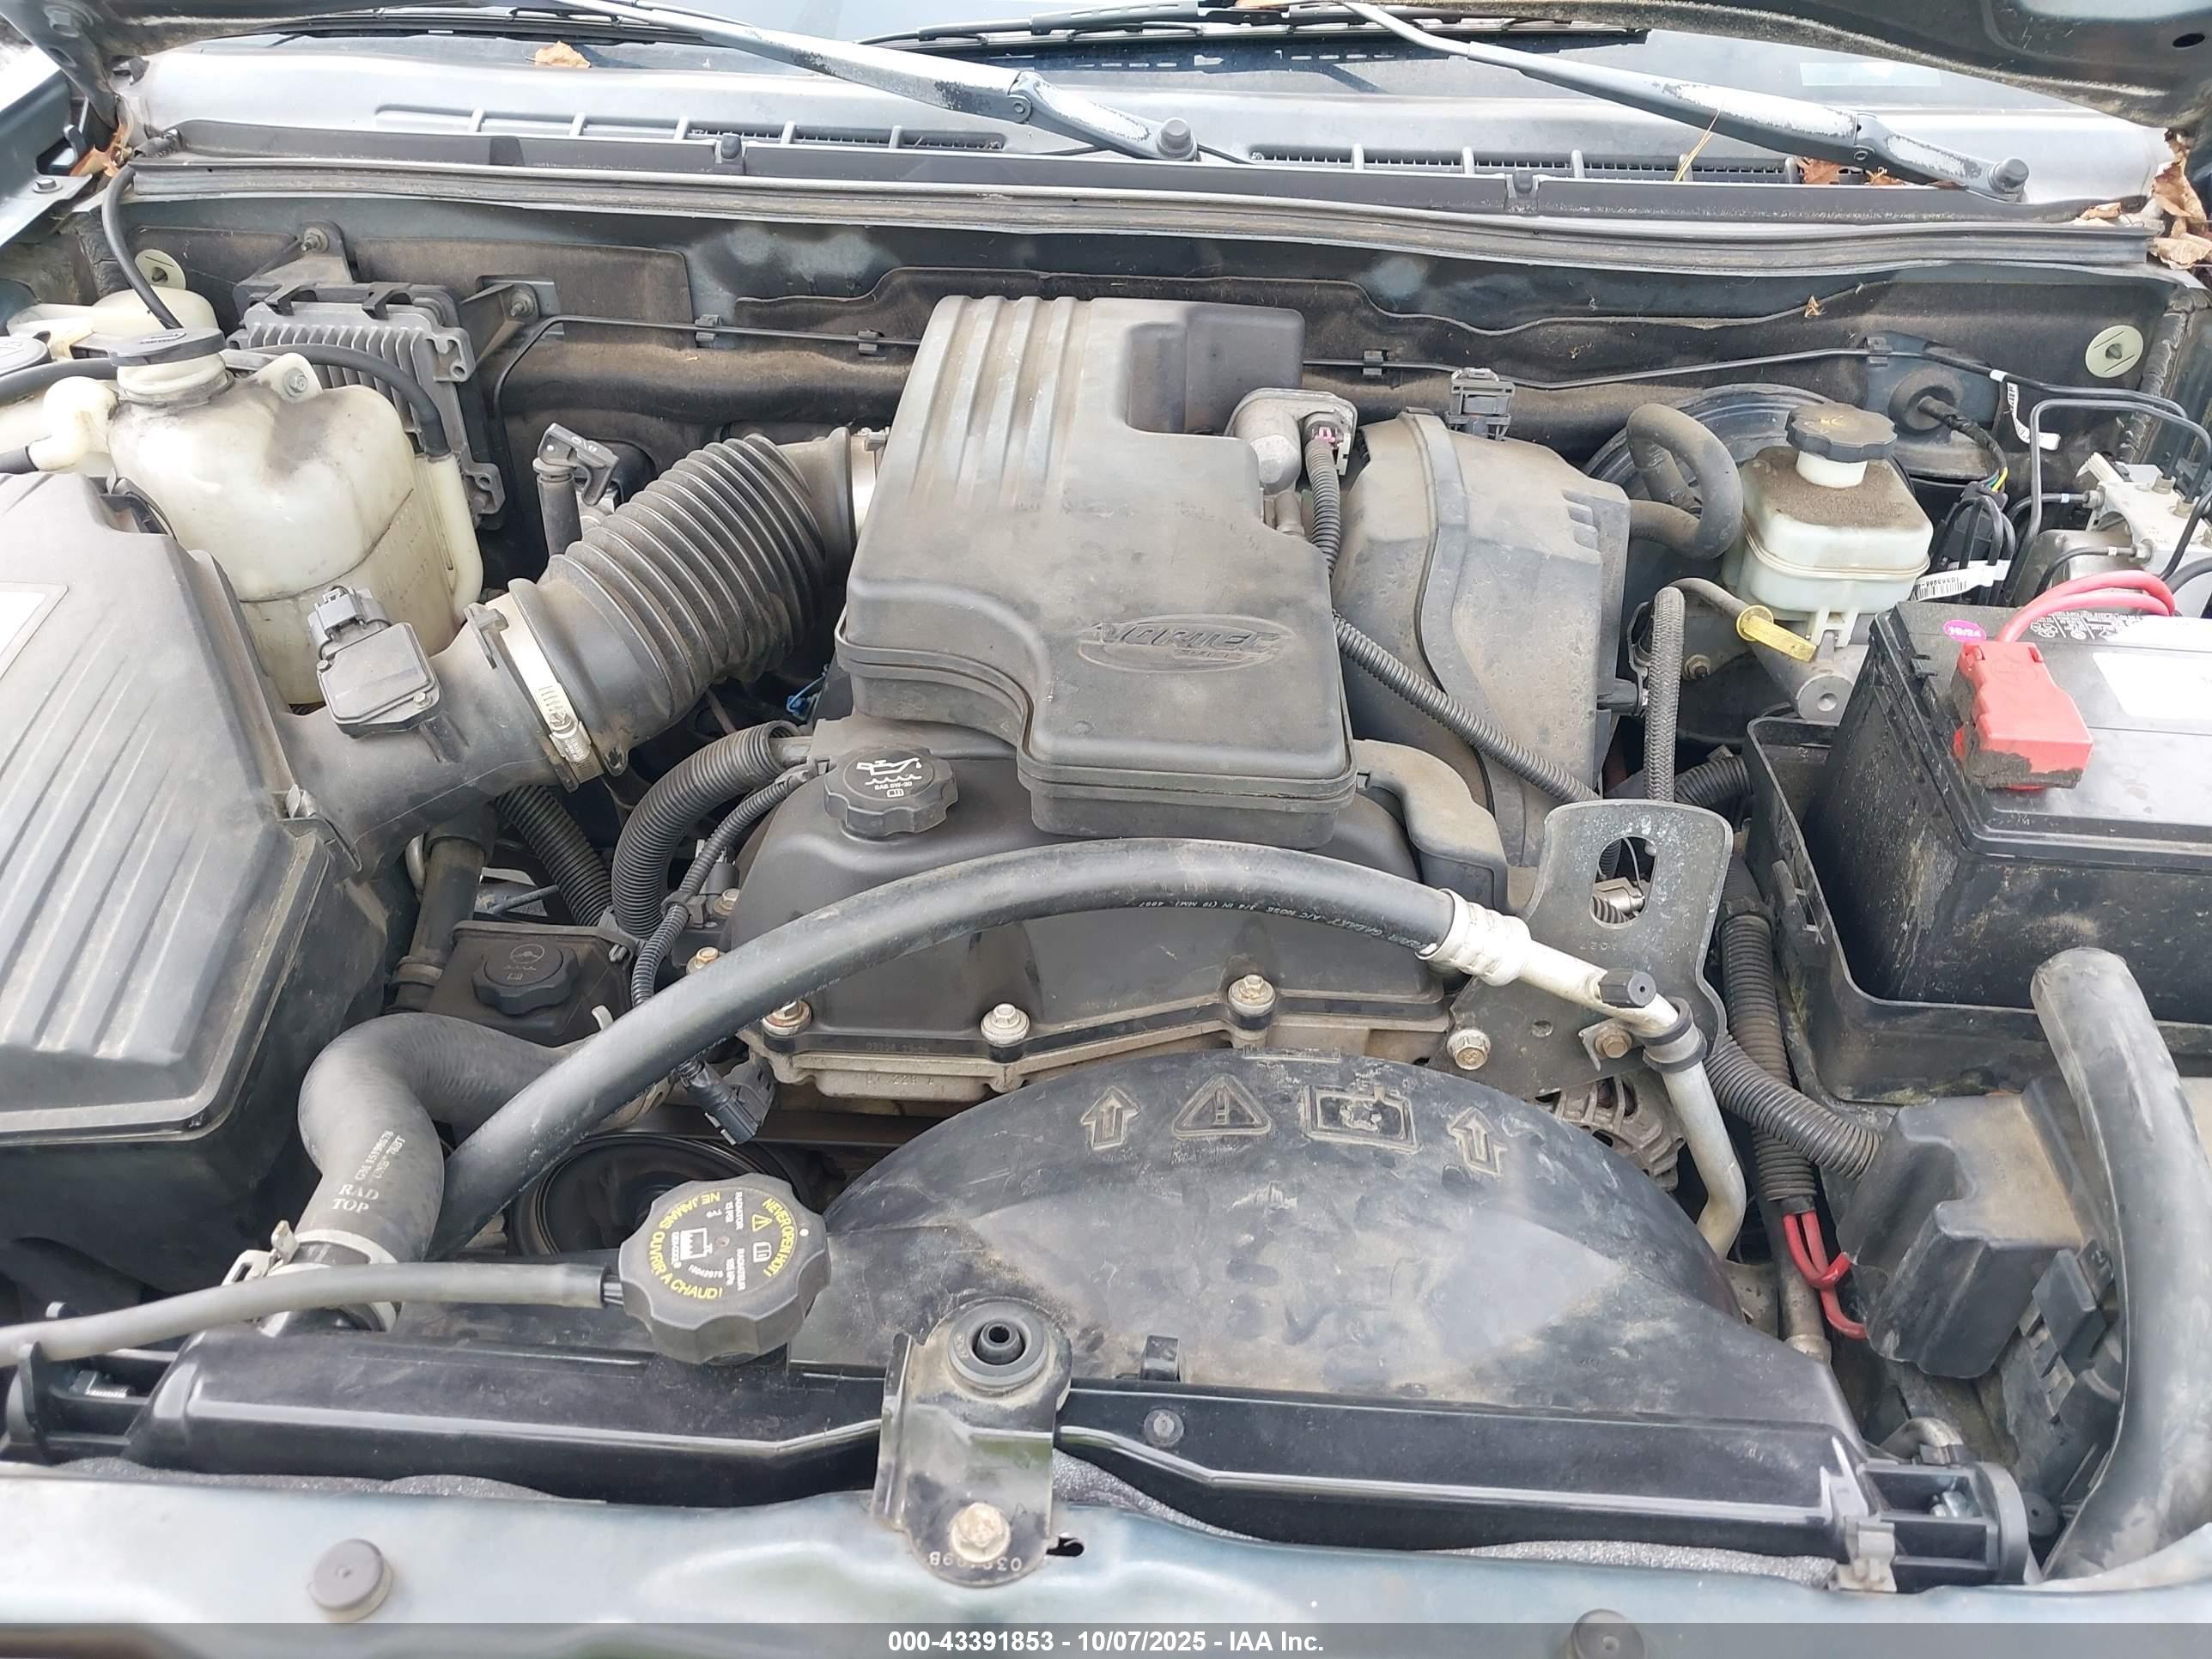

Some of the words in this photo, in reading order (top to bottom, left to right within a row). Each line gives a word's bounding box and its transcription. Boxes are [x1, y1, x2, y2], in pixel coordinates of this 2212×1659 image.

[332, 1198, 369, 1213] TOP
[338, 1184, 379, 1200] RAD
[701, 1191, 720, 1206] NE
[659, 1198, 698, 1230] JAMAIS
[735, 1191, 744, 1231] RADIATOR
[763, 1198, 792, 1228] NEVER
[780, 1225, 794, 1254] OPEN
[649, 1231, 666, 1276] OUVRIR
[737, 1248, 746, 1291] RADIATEUR
